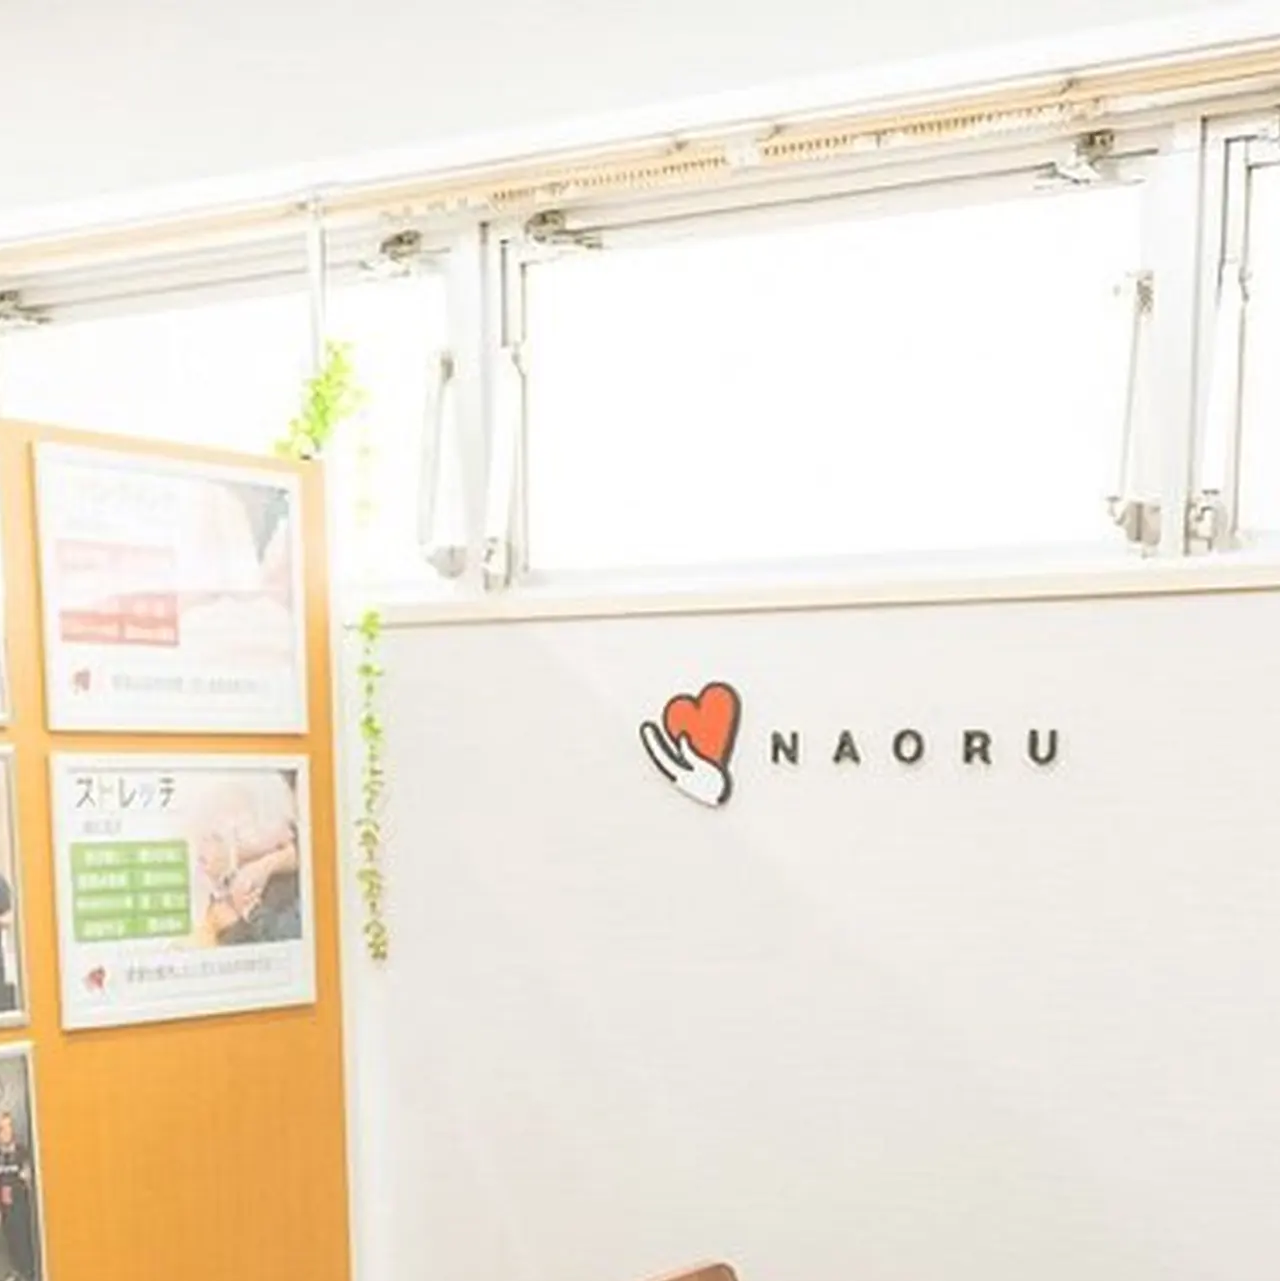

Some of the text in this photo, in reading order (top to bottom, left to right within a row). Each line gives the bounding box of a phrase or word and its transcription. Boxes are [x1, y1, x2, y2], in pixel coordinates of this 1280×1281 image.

[770, 727, 1059, 767] NAORU
[75, 776, 177, 809] ストレッチ
